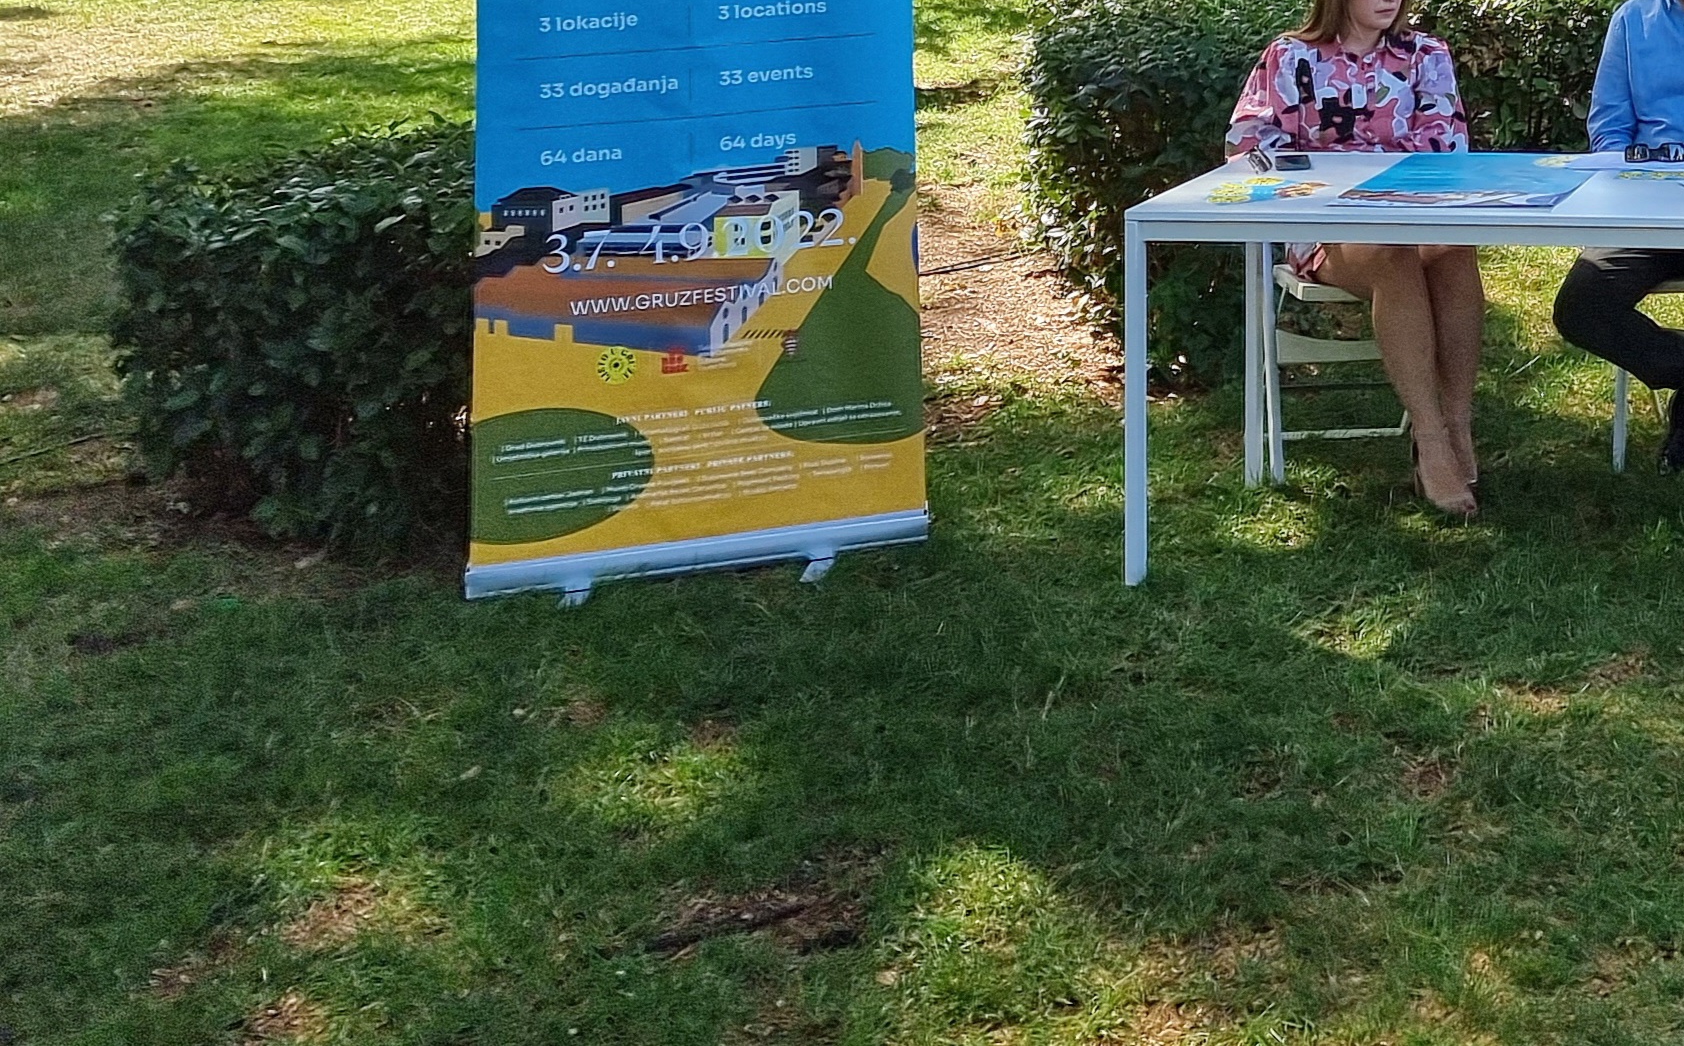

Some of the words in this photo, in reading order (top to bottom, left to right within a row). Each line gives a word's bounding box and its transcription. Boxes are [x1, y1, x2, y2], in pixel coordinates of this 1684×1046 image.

[718, 5, 730, 20] 3
[733, 0, 827, 19] locations
[539, 16, 552, 33] 3
[556, 11, 639, 32] lokacije
[719, 69, 743, 86] 33
[747, 65, 814, 83] events
[539, 83, 564, 99] 33
[569, 75, 679, 99] događanja
[720, 136, 746, 151] 64
[750, 133, 797, 150] days
[540, 149, 567, 166] 64
[572, 147, 623, 163] dana
